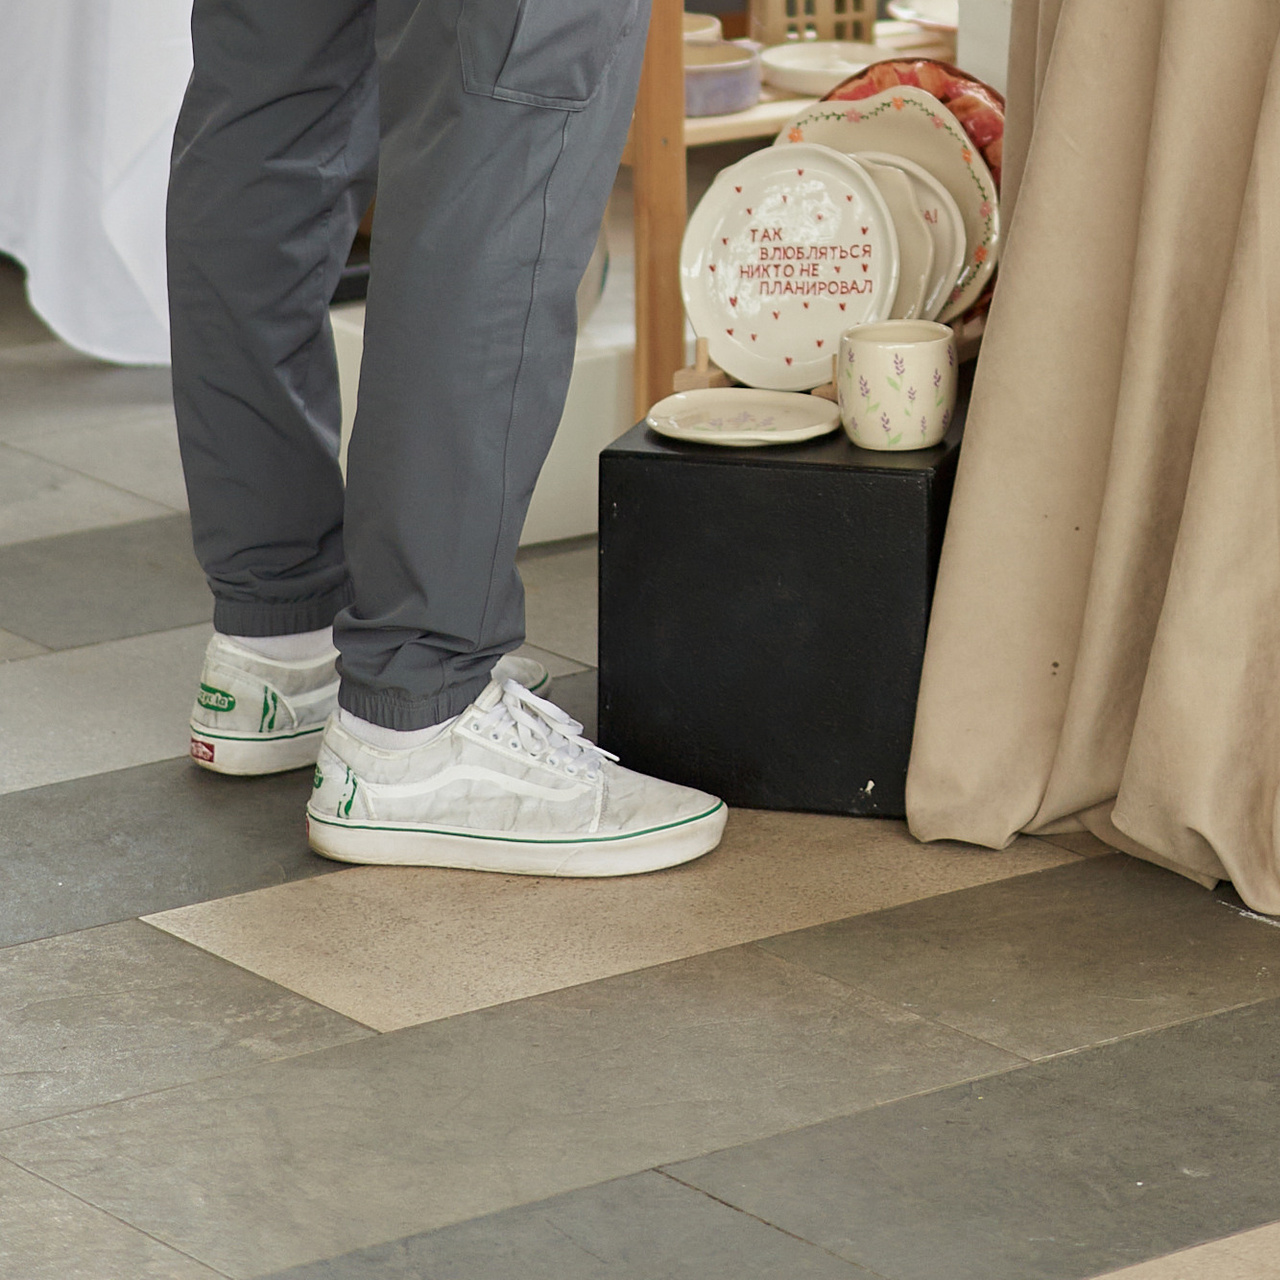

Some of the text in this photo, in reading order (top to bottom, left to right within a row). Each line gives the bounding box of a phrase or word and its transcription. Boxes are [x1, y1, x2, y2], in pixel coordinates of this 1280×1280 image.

[750, 227, 783, 243] ТАК
[759, 243, 873, 261] ВЛЮБЛЯТЬСЯ
[739, 262, 820, 279] НИКТО НЕ
[758, 279, 873, 296] ПЛАНИРОВАЛ
